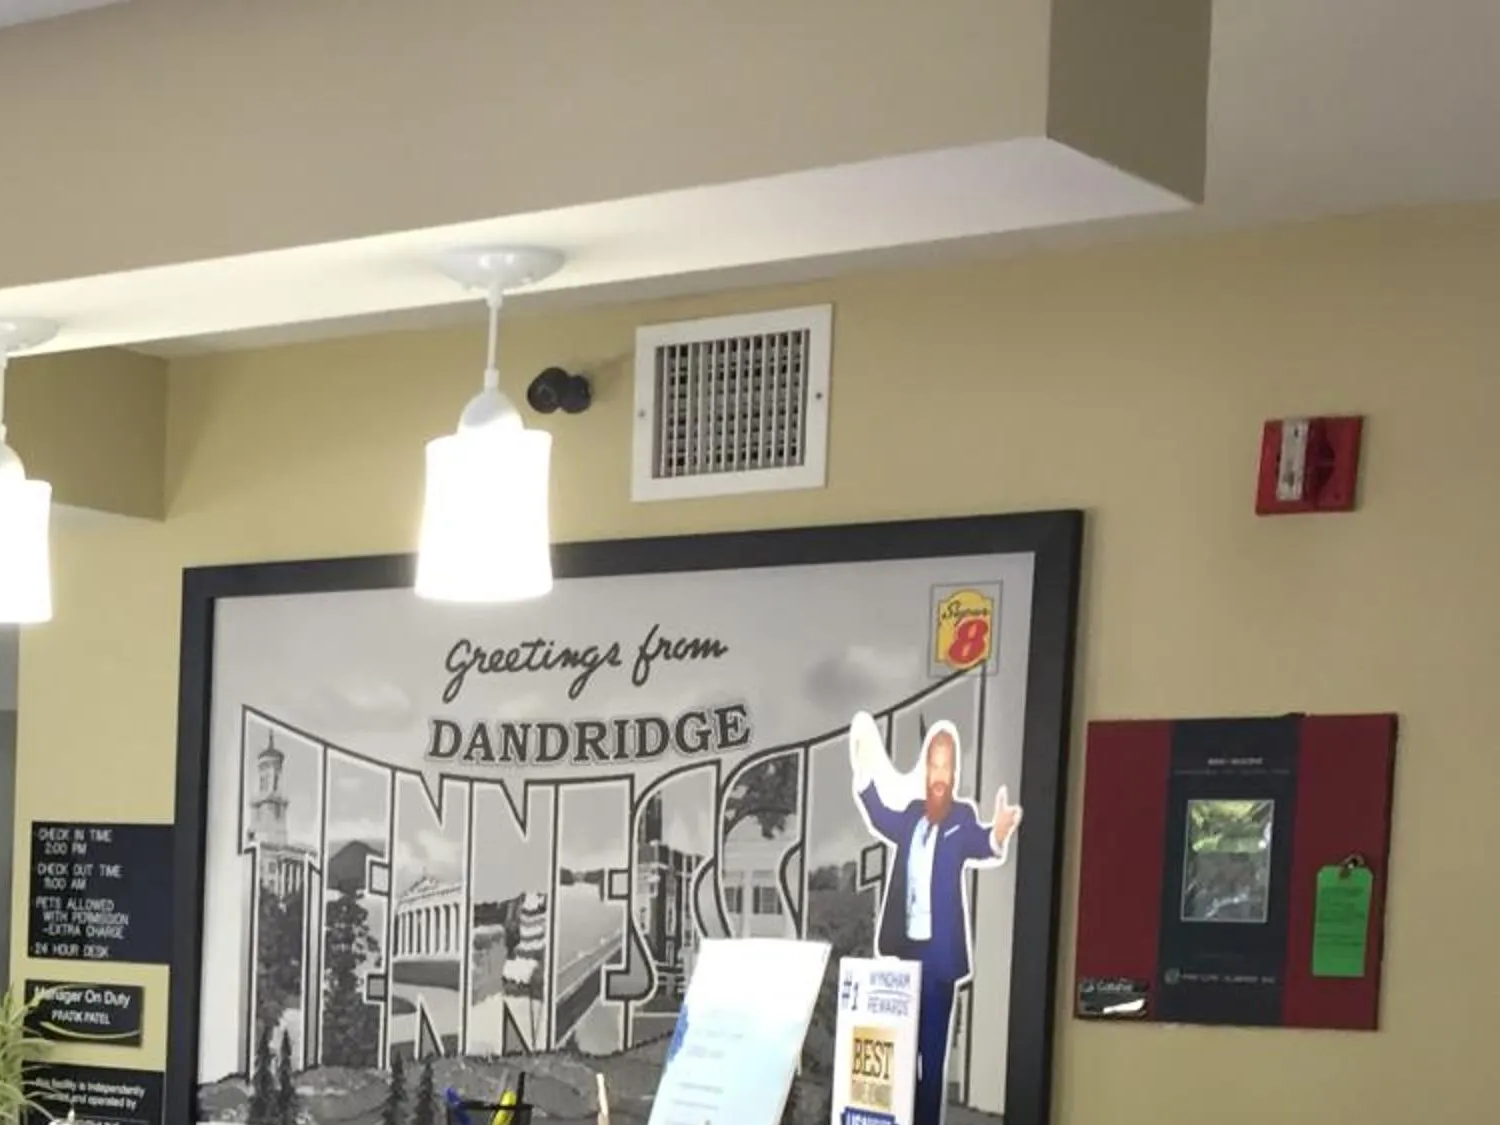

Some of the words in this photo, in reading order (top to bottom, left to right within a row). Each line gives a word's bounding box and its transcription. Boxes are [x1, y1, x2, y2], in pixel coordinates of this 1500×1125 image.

[947, 617, 989, 666] 8
[442, 638, 623, 704] Greetings
[631, 623, 729, 687] from
[427, 703, 751, 764] DANDRIDGE
[38, 827, 69, 841] CHECK
[90, 828, 113, 842] TIME
[37, 863, 69, 877] CHECK
[73, 863, 94, 877] OUT
[100, 864, 124, 879] TIME
[35, 896, 61, 909] PETS
[67, 898, 115, 912] ALLOWED
[84, 988, 103, 1004] On
[103, 990, 131, 1009] Duty
[851, 1037, 895, 1080] BEST
